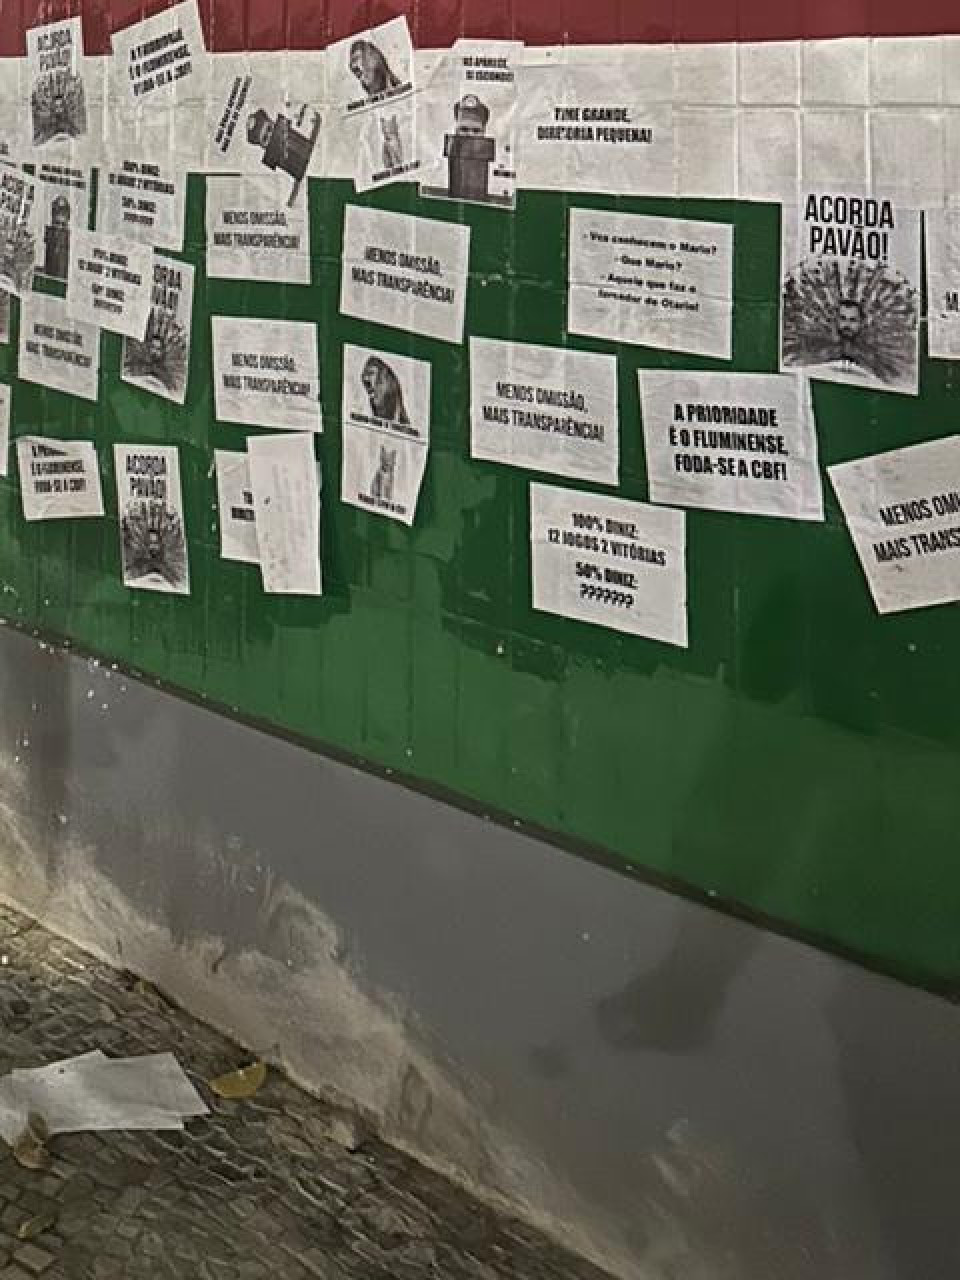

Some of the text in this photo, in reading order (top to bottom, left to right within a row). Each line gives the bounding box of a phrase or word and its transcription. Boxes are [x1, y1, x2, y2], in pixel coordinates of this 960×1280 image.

[554, 107, 631, 123] TIME GRANDE,
[537, 125, 653, 143] DIRETORIA PEQUENA!
[805, 193, 895, 229] ACORDA
[810, 225, 889, 261] PAVÃO!
[364, 246, 397, 267] MENOS
[352, 266, 375, 286] MAIS
[496, 381, 588, 412] MENOS OMISSÃO,
[483, 405, 605, 443] MAIS TRANSPARÊNCIA!
[674, 404, 779, 428] A PRIORIDADE
[680, 429, 690, 447] O
[693, 429, 789, 456] FLUMINENSE,
[675, 453, 787, 481] FODA-SE A CBF!
[879, 499, 933, 527] MENOS
[548, 528, 560, 545] 12
[872, 537, 911, 563] MAIS
